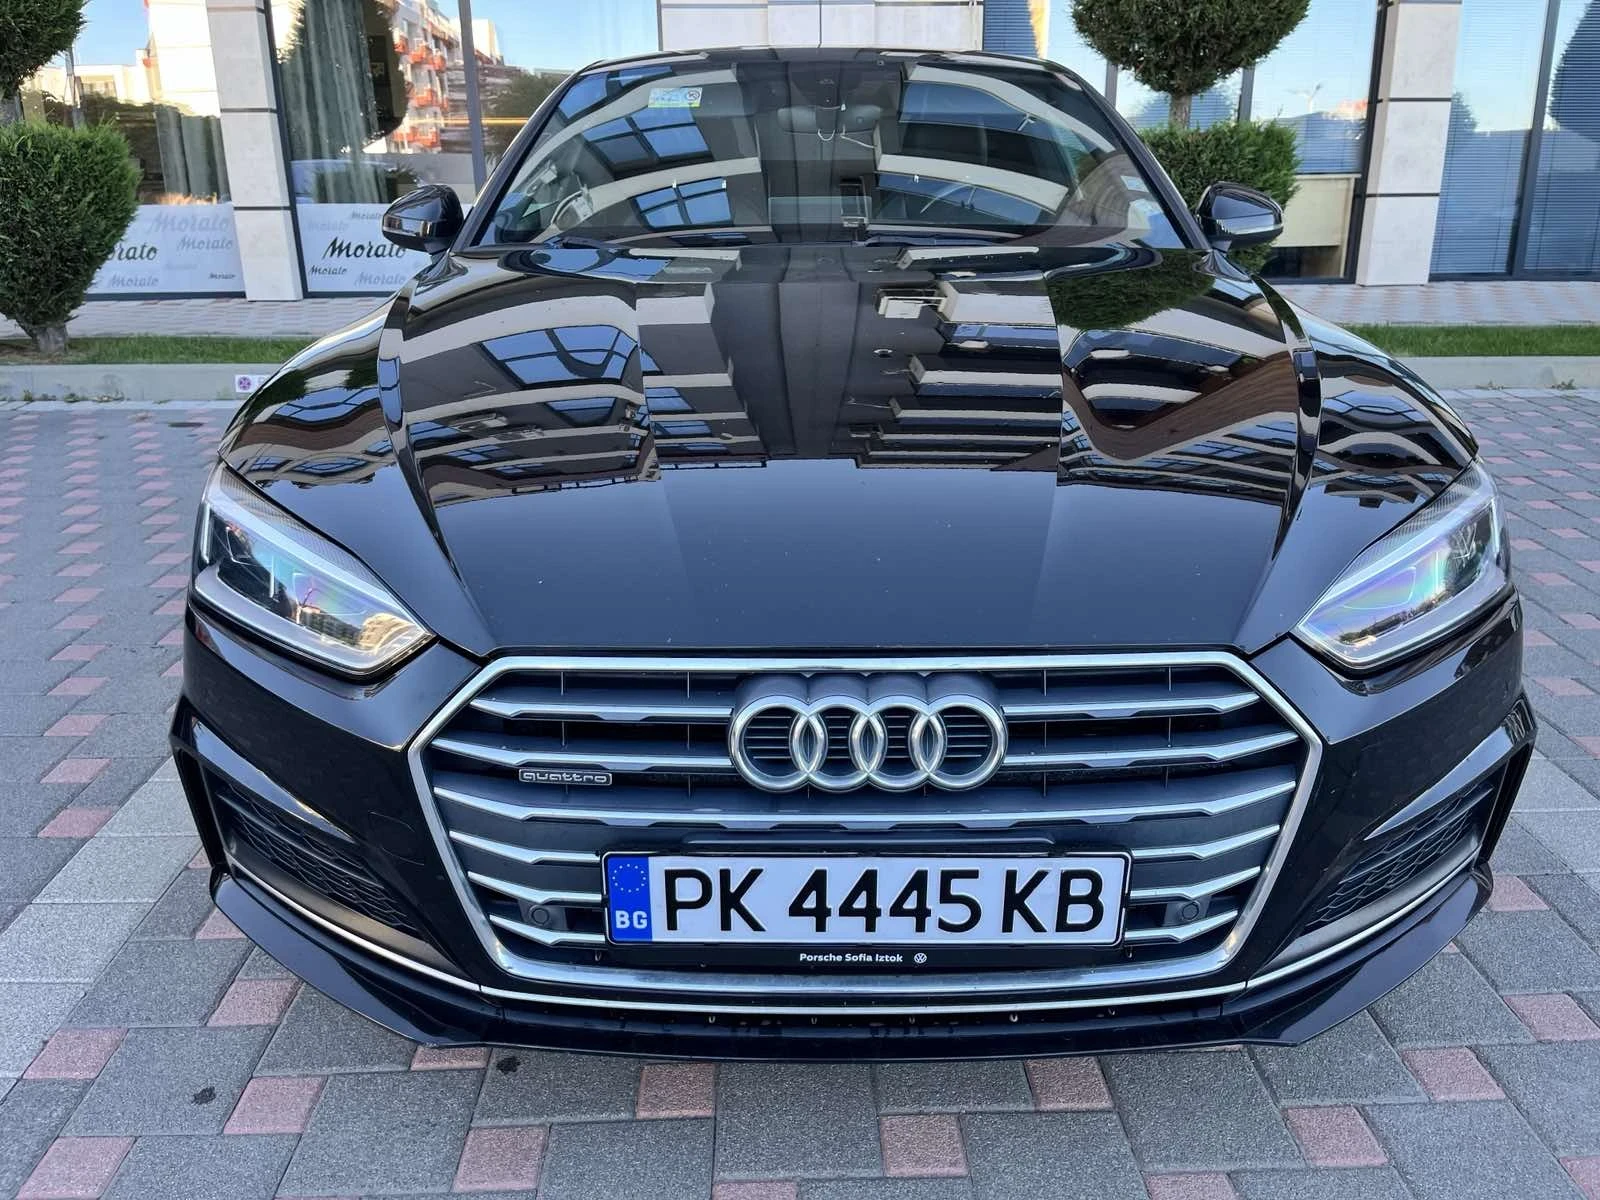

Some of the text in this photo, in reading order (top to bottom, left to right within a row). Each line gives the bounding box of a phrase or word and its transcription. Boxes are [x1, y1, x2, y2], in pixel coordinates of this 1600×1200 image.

[107, 242, 158, 261] orato
[177, 235, 233, 251] Morato
[322, 237, 406, 259] Morato
[308, 265, 347, 276] Morato
[523, 772, 607, 783] quattro
[664, 868, 1105, 933] PK 4445 KB
[615, 910, 648, 929] BG
[800, 953, 903, 963] Porsche Sofia Iztok
